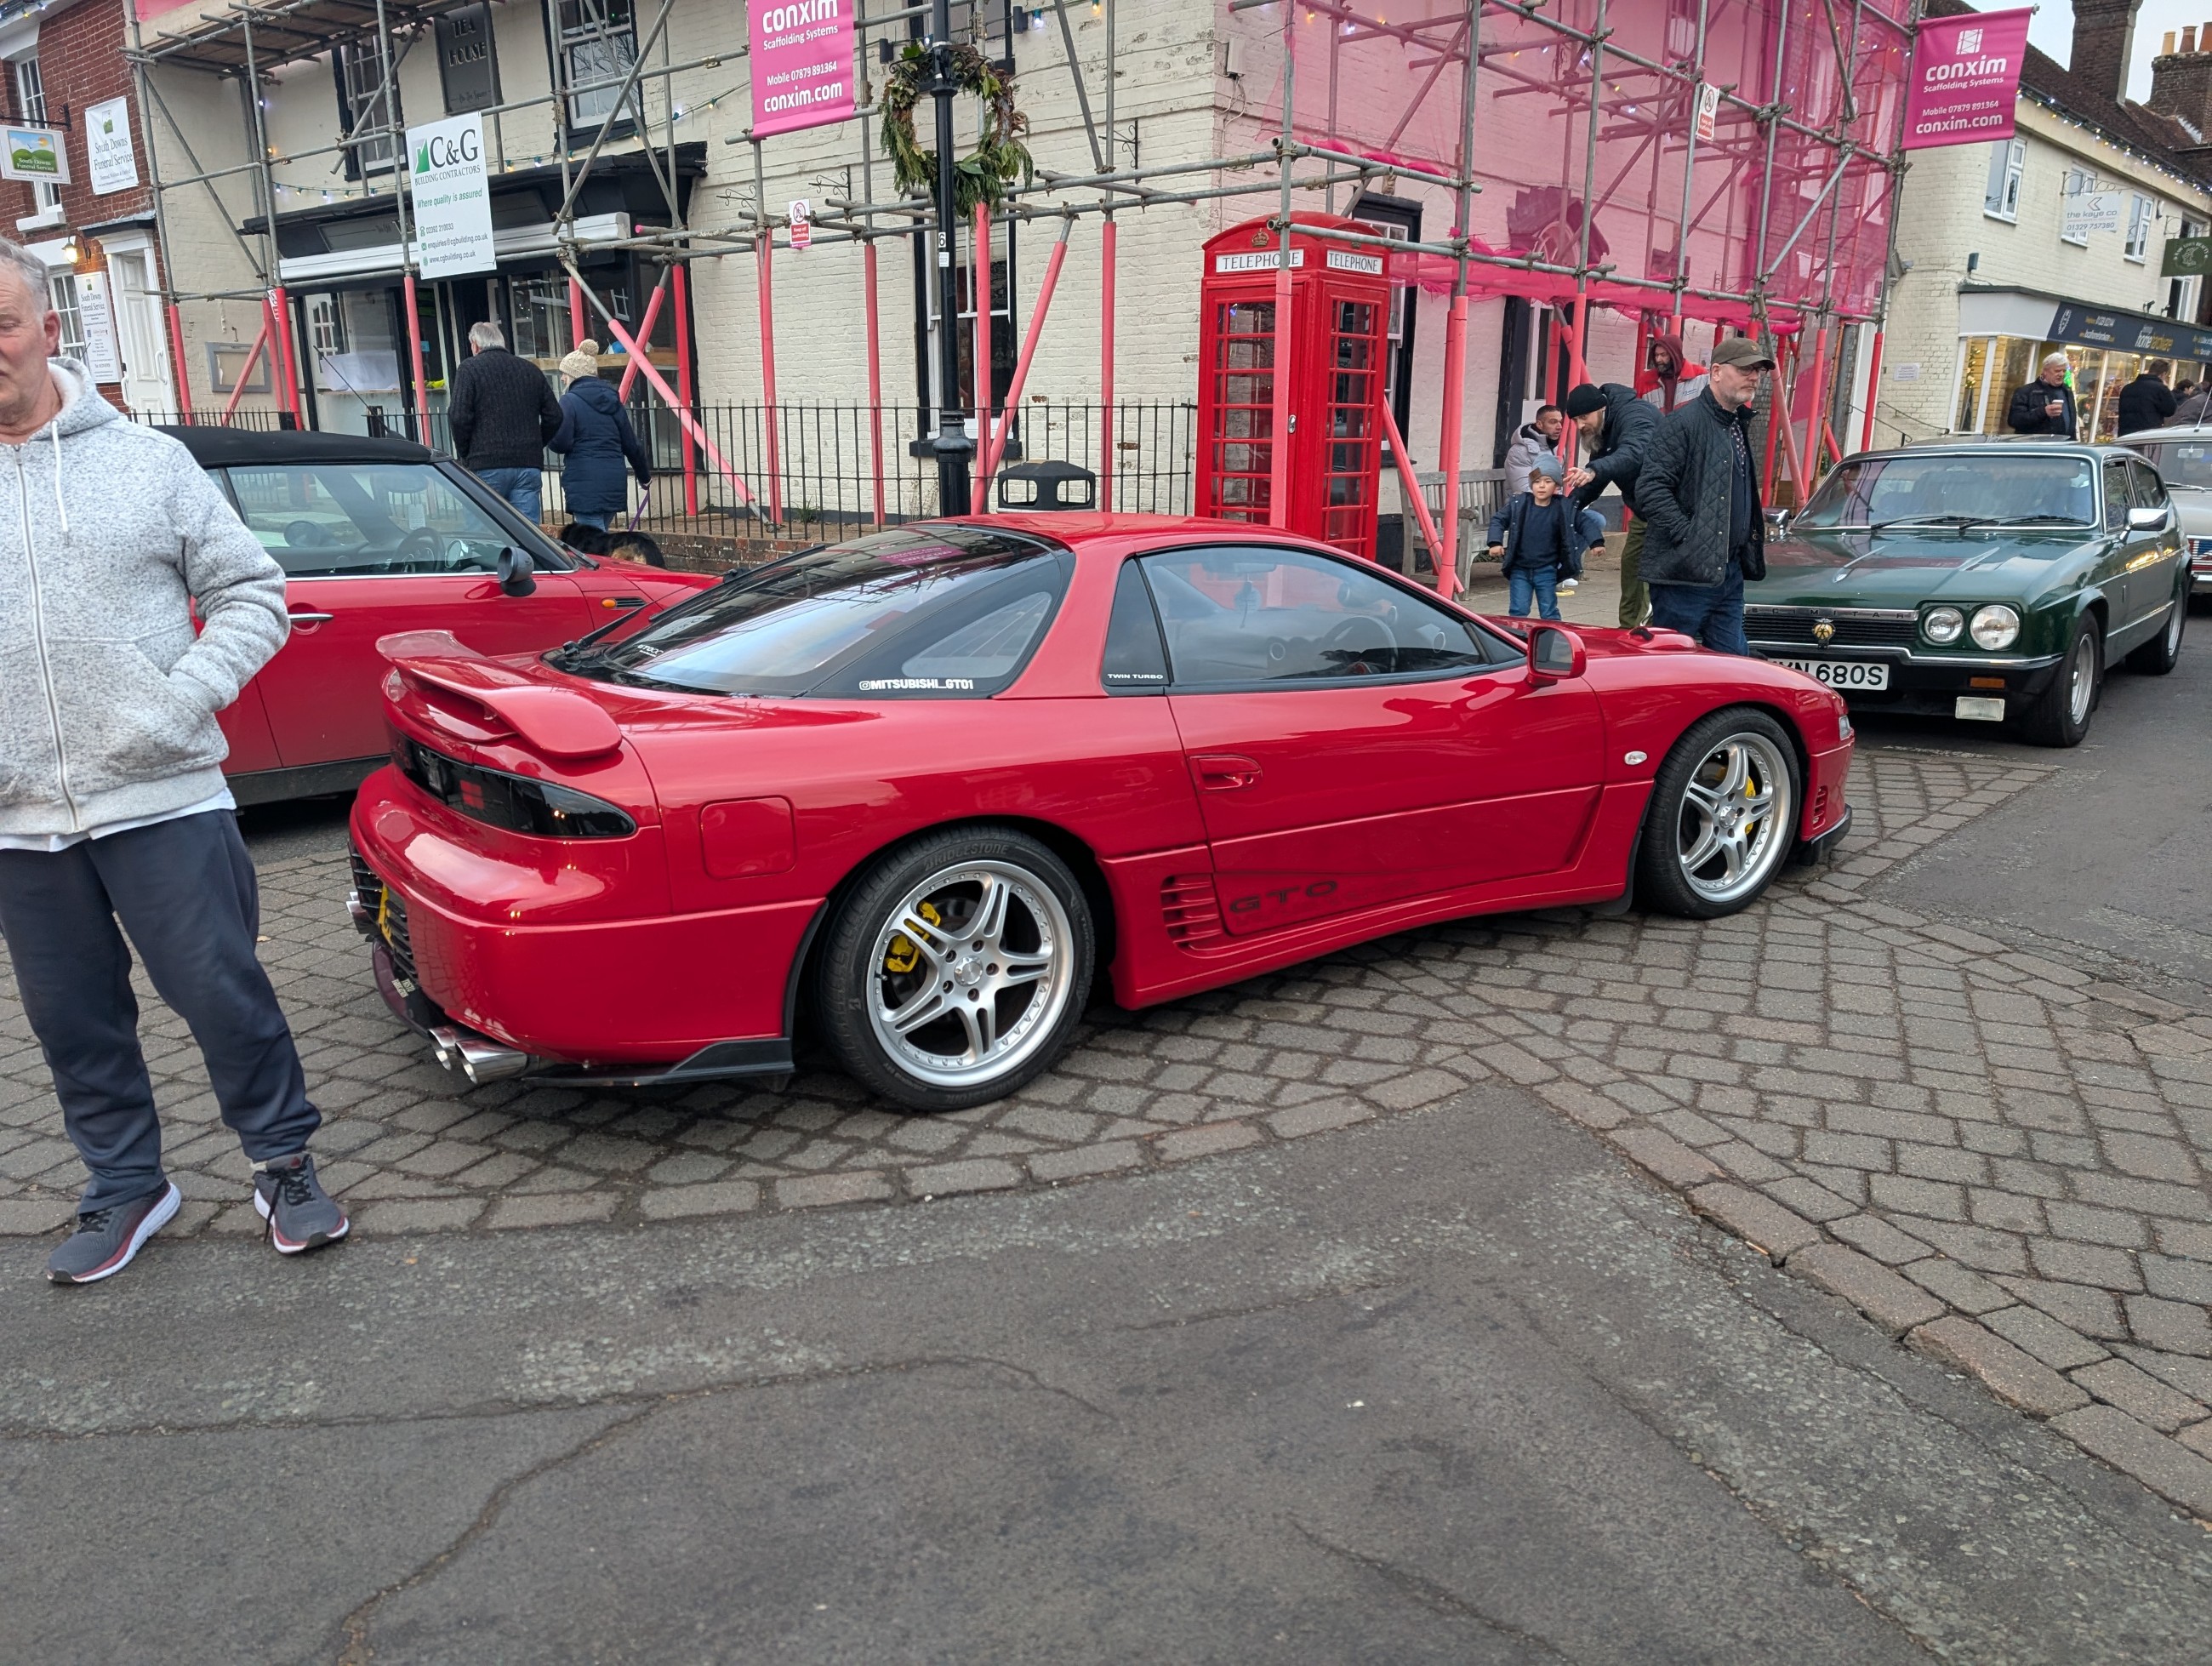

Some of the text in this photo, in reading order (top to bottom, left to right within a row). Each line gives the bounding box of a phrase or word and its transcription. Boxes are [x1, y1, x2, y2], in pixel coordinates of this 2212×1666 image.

[762, 0, 838, 33] conxim
[452, 19, 476, 38] TEA
[763, 25, 838, 50] Scaffolding Systems
[448, 42, 487, 66] HOUSE
[767, 60, 837, 86] Mobile 07879 891364
[1925, 54, 2007, 82] conxim
[1923, 77, 2004, 93] Scaffolding Systems
[764, 82, 842, 112] conxim.com
[1923, 100, 1999, 117] Mobile 07879 891364
[1916, 114, 2003, 134] conxim.com
[94, 137, 128, 153] South Downs
[430, 128, 478, 168] C&G
[94, 151, 133, 171] Funeral Service
[414, 165, 481, 186] BUILDING CONTRACTORS
[417, 188, 482, 208] Where quality is assured
[439, 223, 453, 232] 210033
[428, 232, 488, 249] enquiries@cgbuilding.co.uk
[939, 233, 945, 246] 6
[429, 250, 476, 264] www.cgbuilding.co.uk
[1223, 252, 1300, 270] TELEPHOE
[1329, 252, 1378, 272] TELEPHONE
[1752, 607, 1904, 619] SCIMITAR
[1816, 663, 1883, 686] 680S
[1229, 880, 1338, 913] GTO
